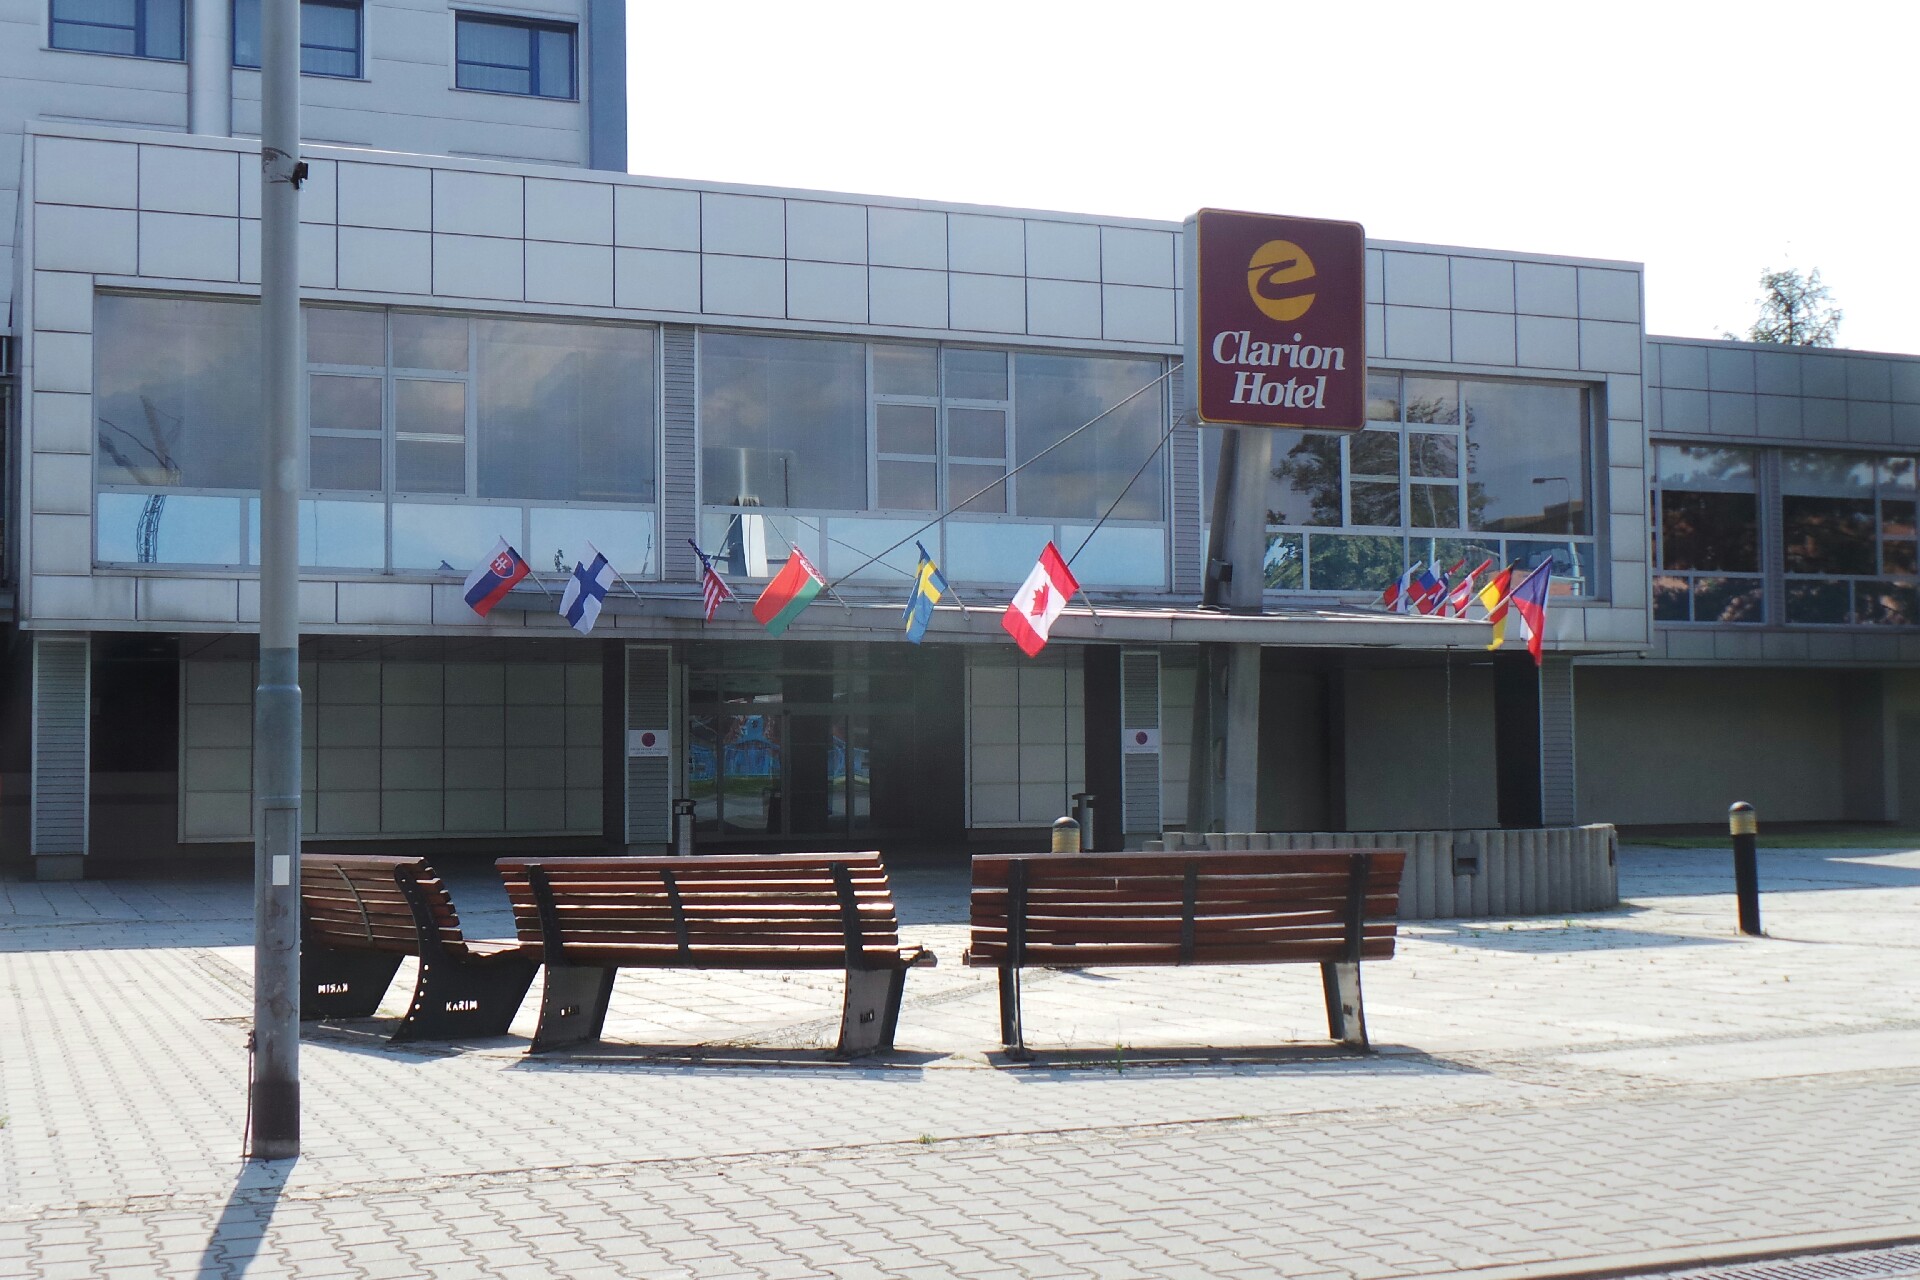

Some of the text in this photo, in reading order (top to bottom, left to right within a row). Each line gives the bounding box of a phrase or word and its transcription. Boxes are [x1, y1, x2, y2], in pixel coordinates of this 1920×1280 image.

[1213, 330, 1346, 371] Clarion
[1229, 371, 1326, 409] Hotel
[445, 1000, 478, 1012] KARIM
